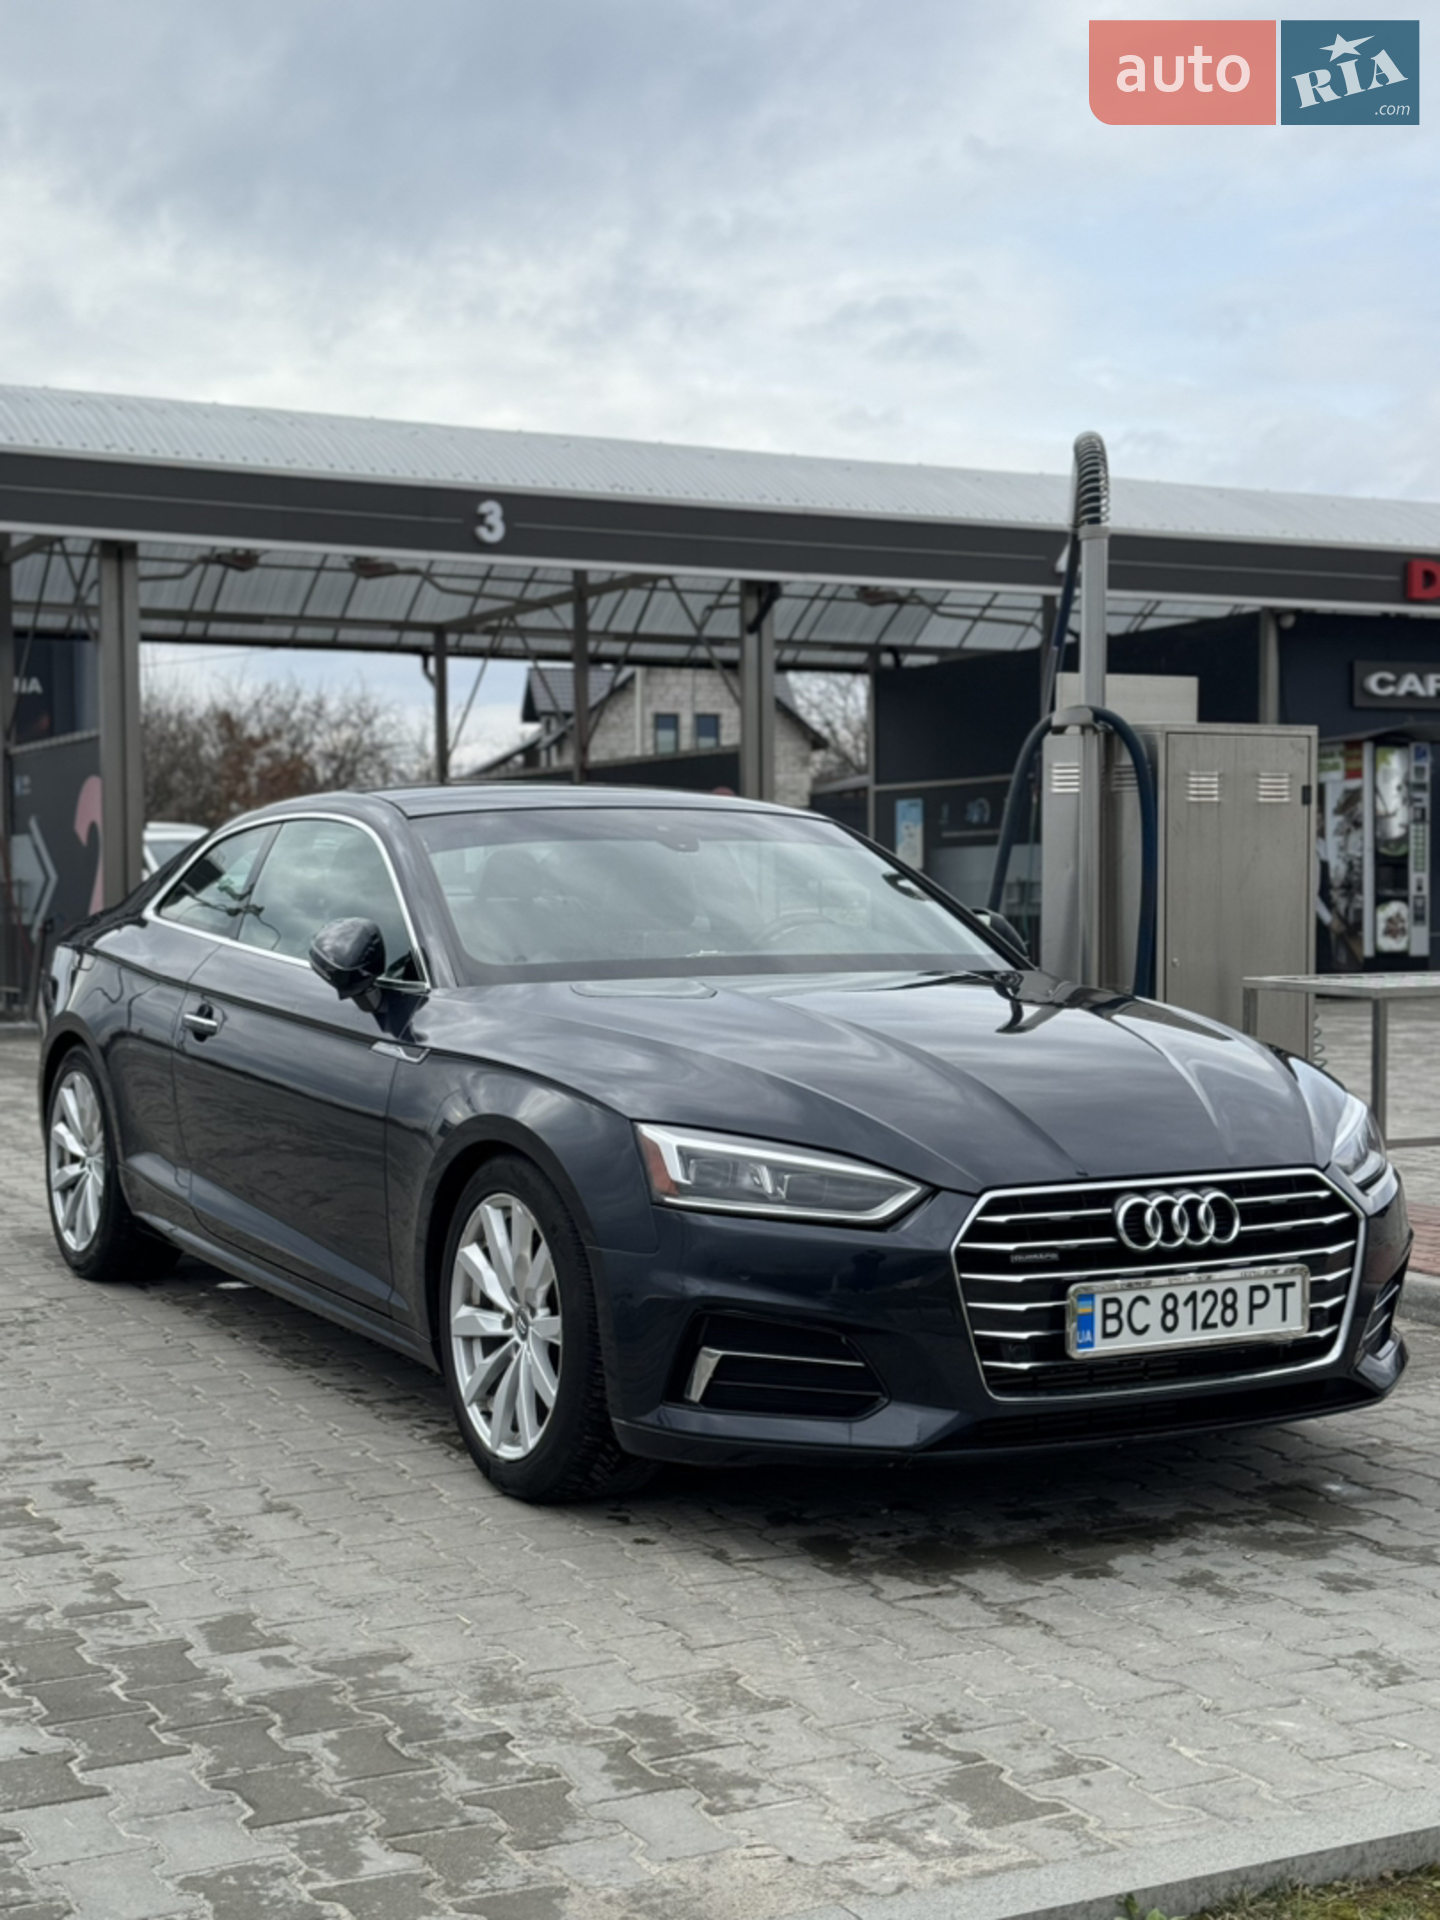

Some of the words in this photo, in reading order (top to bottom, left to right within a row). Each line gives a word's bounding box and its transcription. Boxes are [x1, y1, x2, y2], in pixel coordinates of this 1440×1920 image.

[474, 498, 506, 544] 3
[1101, 1294, 1151, 1340] BC
[1161, 1286, 1238, 1334] 8128
[1248, 1281, 1296, 1326] PT
[1077, 1329, 1093, 1344] UA
